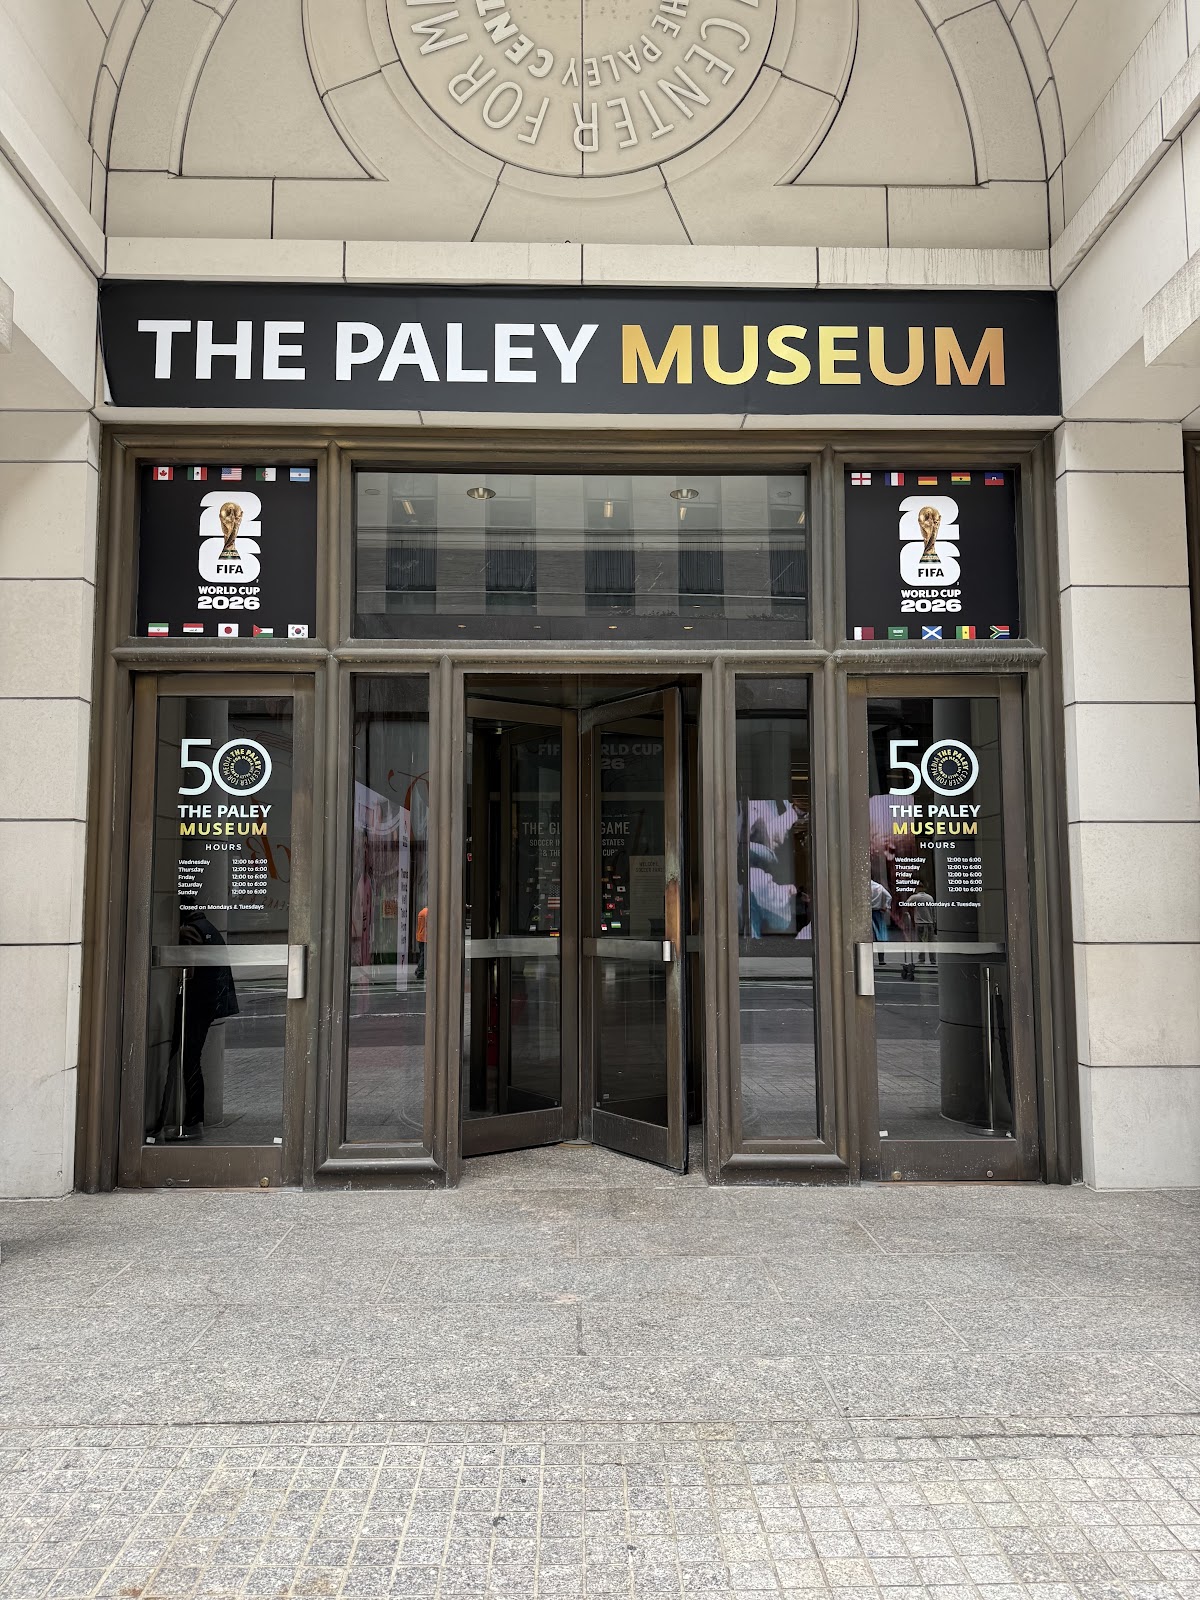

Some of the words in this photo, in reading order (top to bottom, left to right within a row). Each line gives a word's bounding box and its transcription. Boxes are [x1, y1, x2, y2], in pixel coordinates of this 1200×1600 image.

[651, 0, 690, 39] HE
[475, 0, 555, 79] CENT
[560, 33, 664, 88] PALEY
[572, 17, 751, 153] CENTER
[447, 54, 551, 146] FOR
[138, 320, 306, 381] THE
[335, 321, 600, 384] PALEY
[622, 324, 1006, 386] MUSEUM
[216, 564, 244, 574] FIFA
[917, 568, 945, 578] FIFA
[198, 585, 237, 595] WORLD
[238, 586, 261, 595] CUP
[900, 589, 939, 598] WORLD
[940, 589, 962, 598] CUP
[197, 596, 261, 611] 2026
[900, 598, 962, 613] 2026
[230, 748, 245, 757] THE
[538, 743, 560, 756] FIF
[601, 743, 629, 756] RLD
[632, 743, 663, 756] CUP
[937, 749, 952, 758] THE
[222, 756, 232, 776] MEDIA
[246, 749, 262, 770] PALEY
[601, 758, 625, 770] 26
[931, 756, 940, 776] MEDIA
[952, 750, 969, 770] PALEY
[178, 738, 273, 797] 50
[888, 739, 980, 797] 50
[227, 775, 239, 786] FOR
[936, 775, 947, 786] FOR
[177, 804, 212, 818] THE
[217, 804, 272, 818] PALEY
[889, 804, 923, 818] THE
[928, 804, 981, 818] PALEY
[179, 822, 267, 836] MUSEUM
[522, 822, 545, 835] THE
[600, 821, 630, 835] GAME
[892, 821, 978, 835] MUSEUM
[205, 843, 242, 851] HOURS
[529, 839, 554, 847] SOCCER
[601, 838, 625, 846] STATES
[920, 841, 956, 849] HOURS
